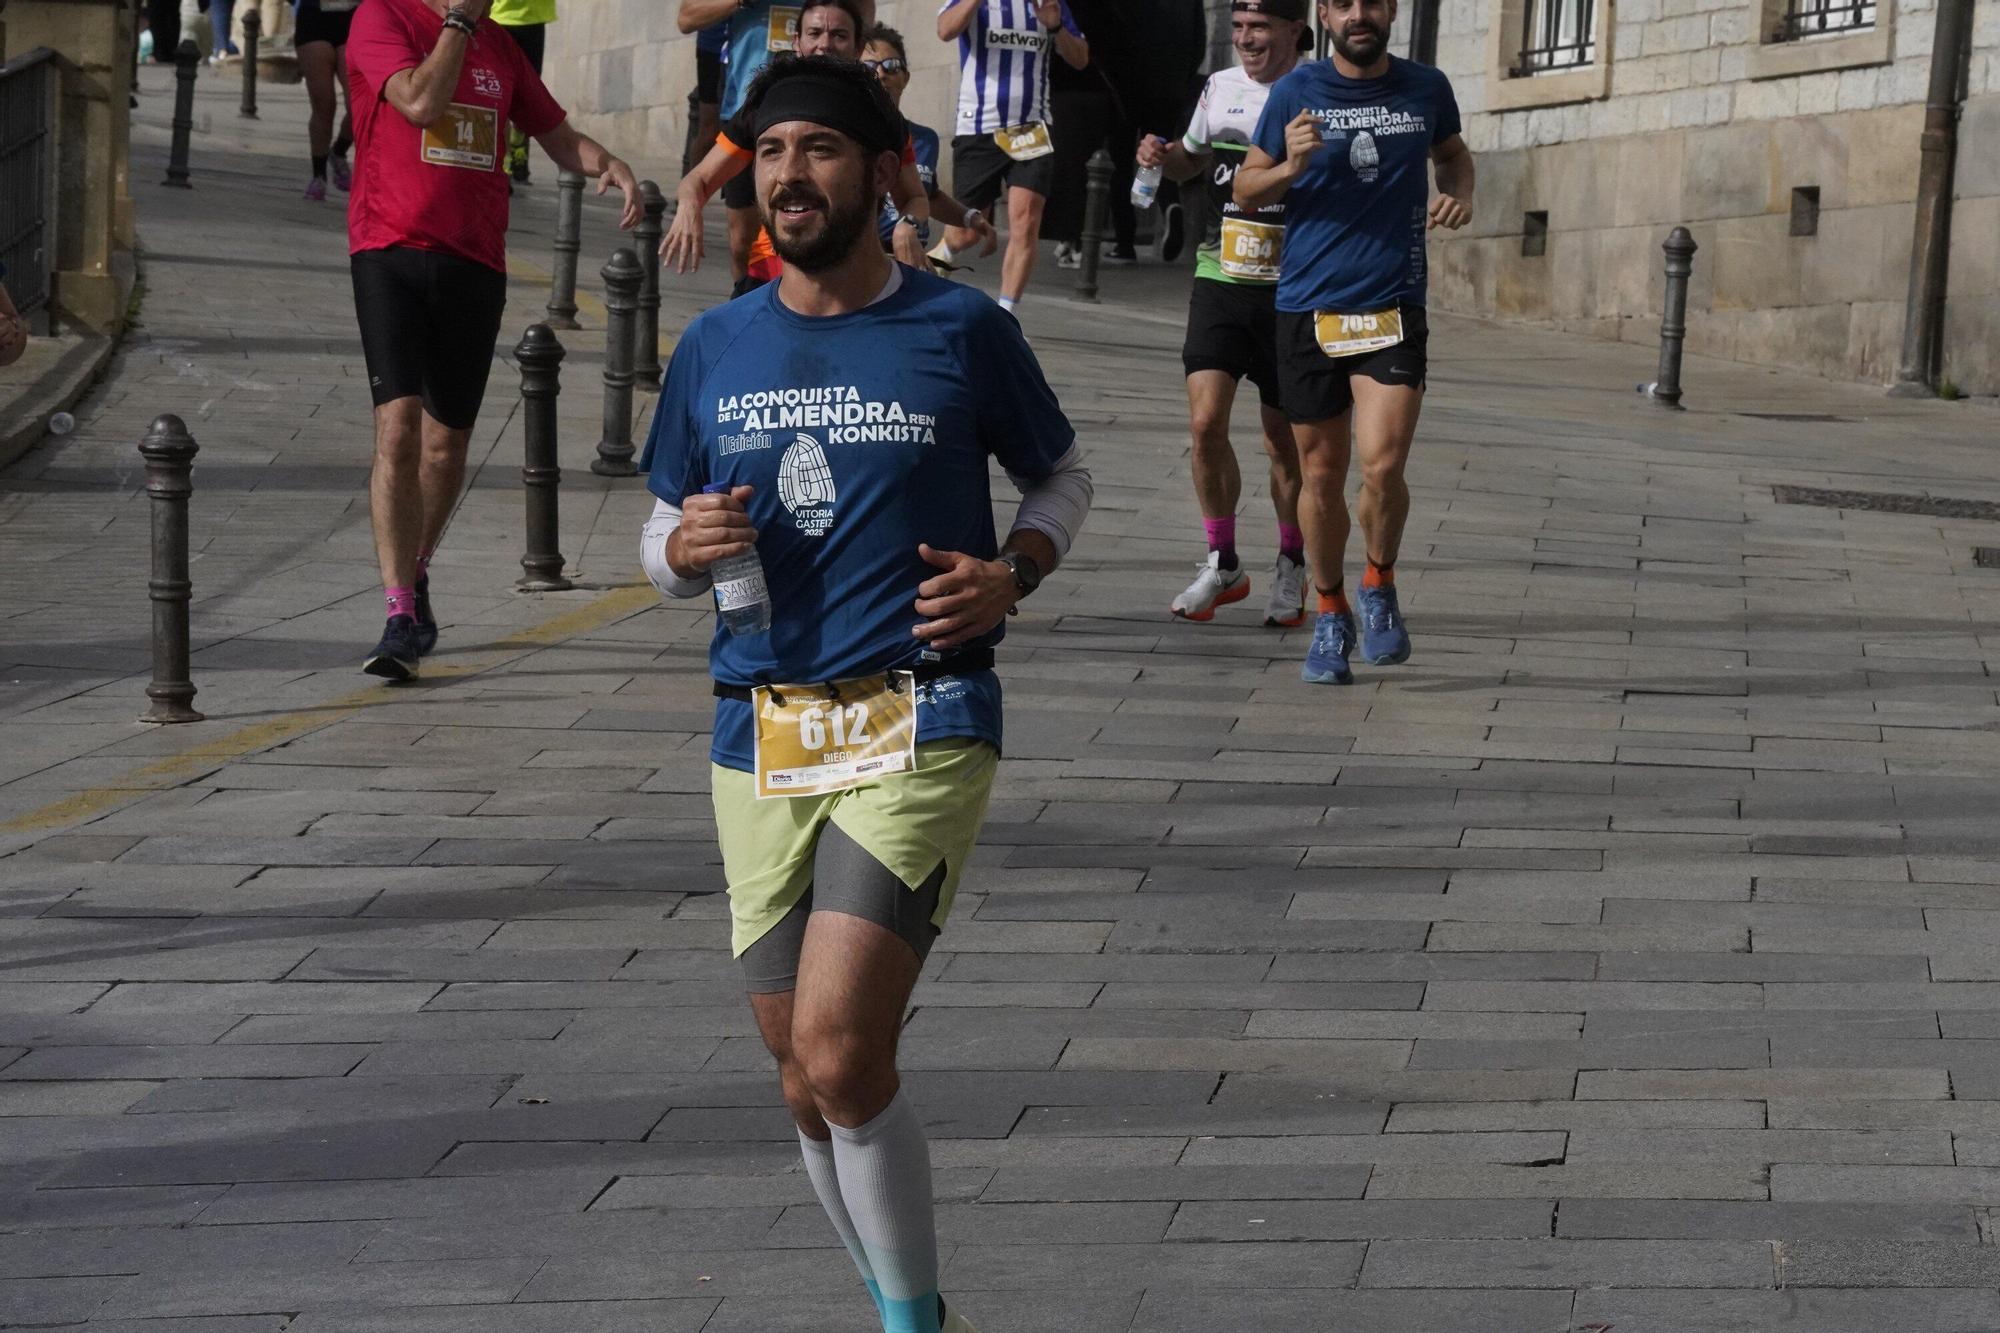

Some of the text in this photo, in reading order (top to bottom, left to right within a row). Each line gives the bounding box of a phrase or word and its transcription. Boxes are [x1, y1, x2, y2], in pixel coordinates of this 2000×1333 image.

[989, 30, 1046, 50] betway
[1326, 106, 1389, 118] CONQUISTA
[1329, 112, 1412, 129] ALMENDRA
[456, 121, 473, 143] 14
[1374, 123, 1426, 136] KONKISTA
[1236, 235, 1272, 258] 654
[1338, 315, 1377, 333] 705
[719, 386, 860, 412] LA CONQUISTA
[718, 401, 935, 431] DE LA ALMENDRA REN
[728, 431, 772, 453] Edición
[829, 425, 936, 445] KONKISTA
[796, 509, 833, 518] VITORIA
[796, 519, 833, 528] GASTEIZ
[800, 702, 870, 750] 612
[823, 750, 853, 763] DIEGO
